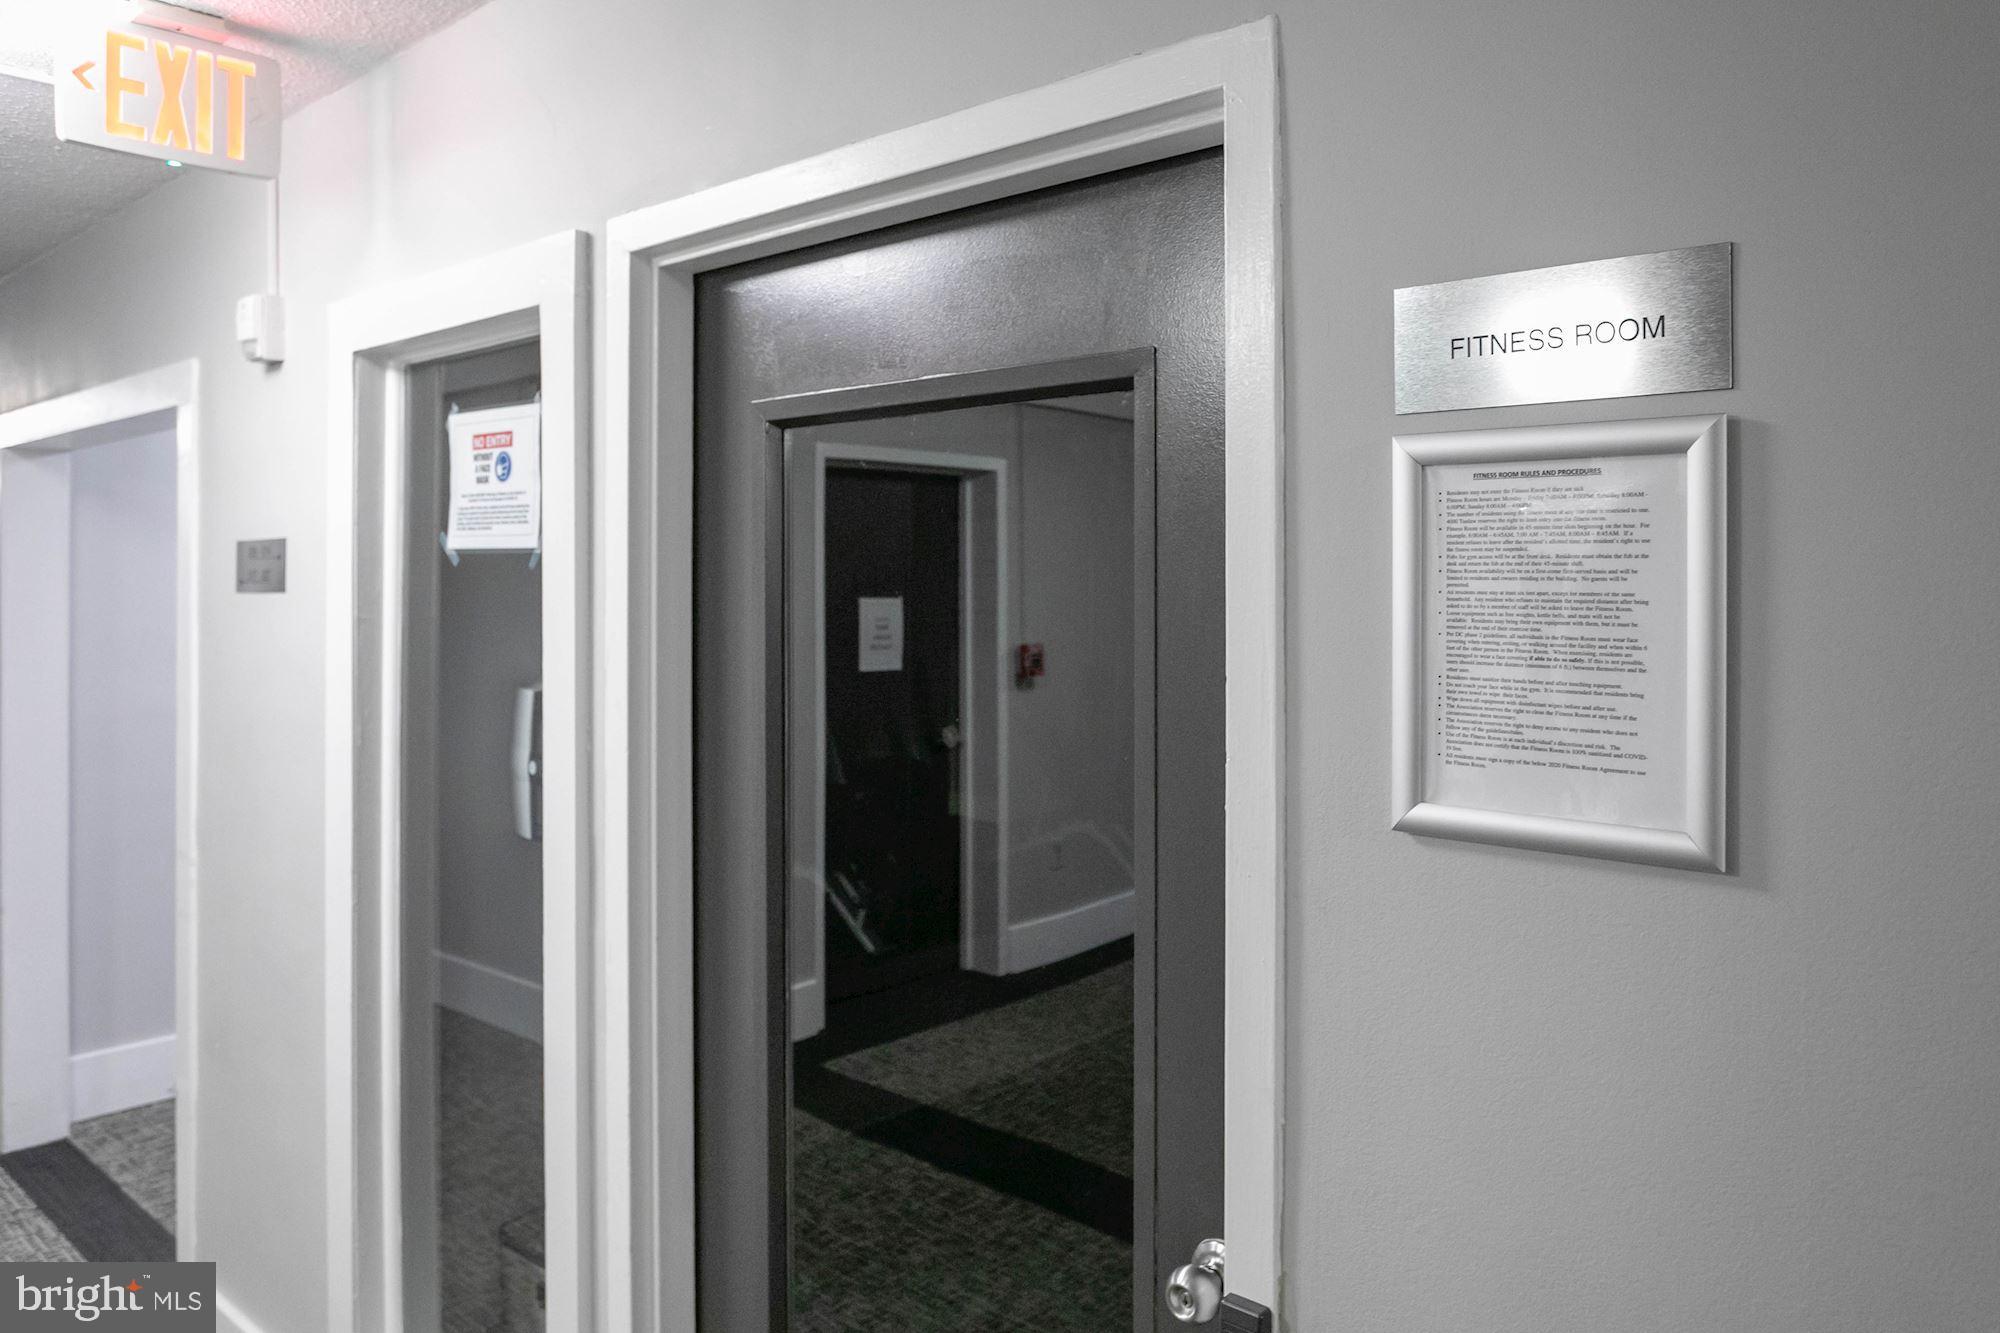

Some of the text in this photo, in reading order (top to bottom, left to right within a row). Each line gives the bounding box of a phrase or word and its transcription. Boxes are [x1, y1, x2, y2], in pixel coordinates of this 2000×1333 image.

[106, 29, 256, 160] EXIT
[1450, 315, 1666, 359] FITNESS ROOM
[474, 434, 512, 448] NO ENTRY
